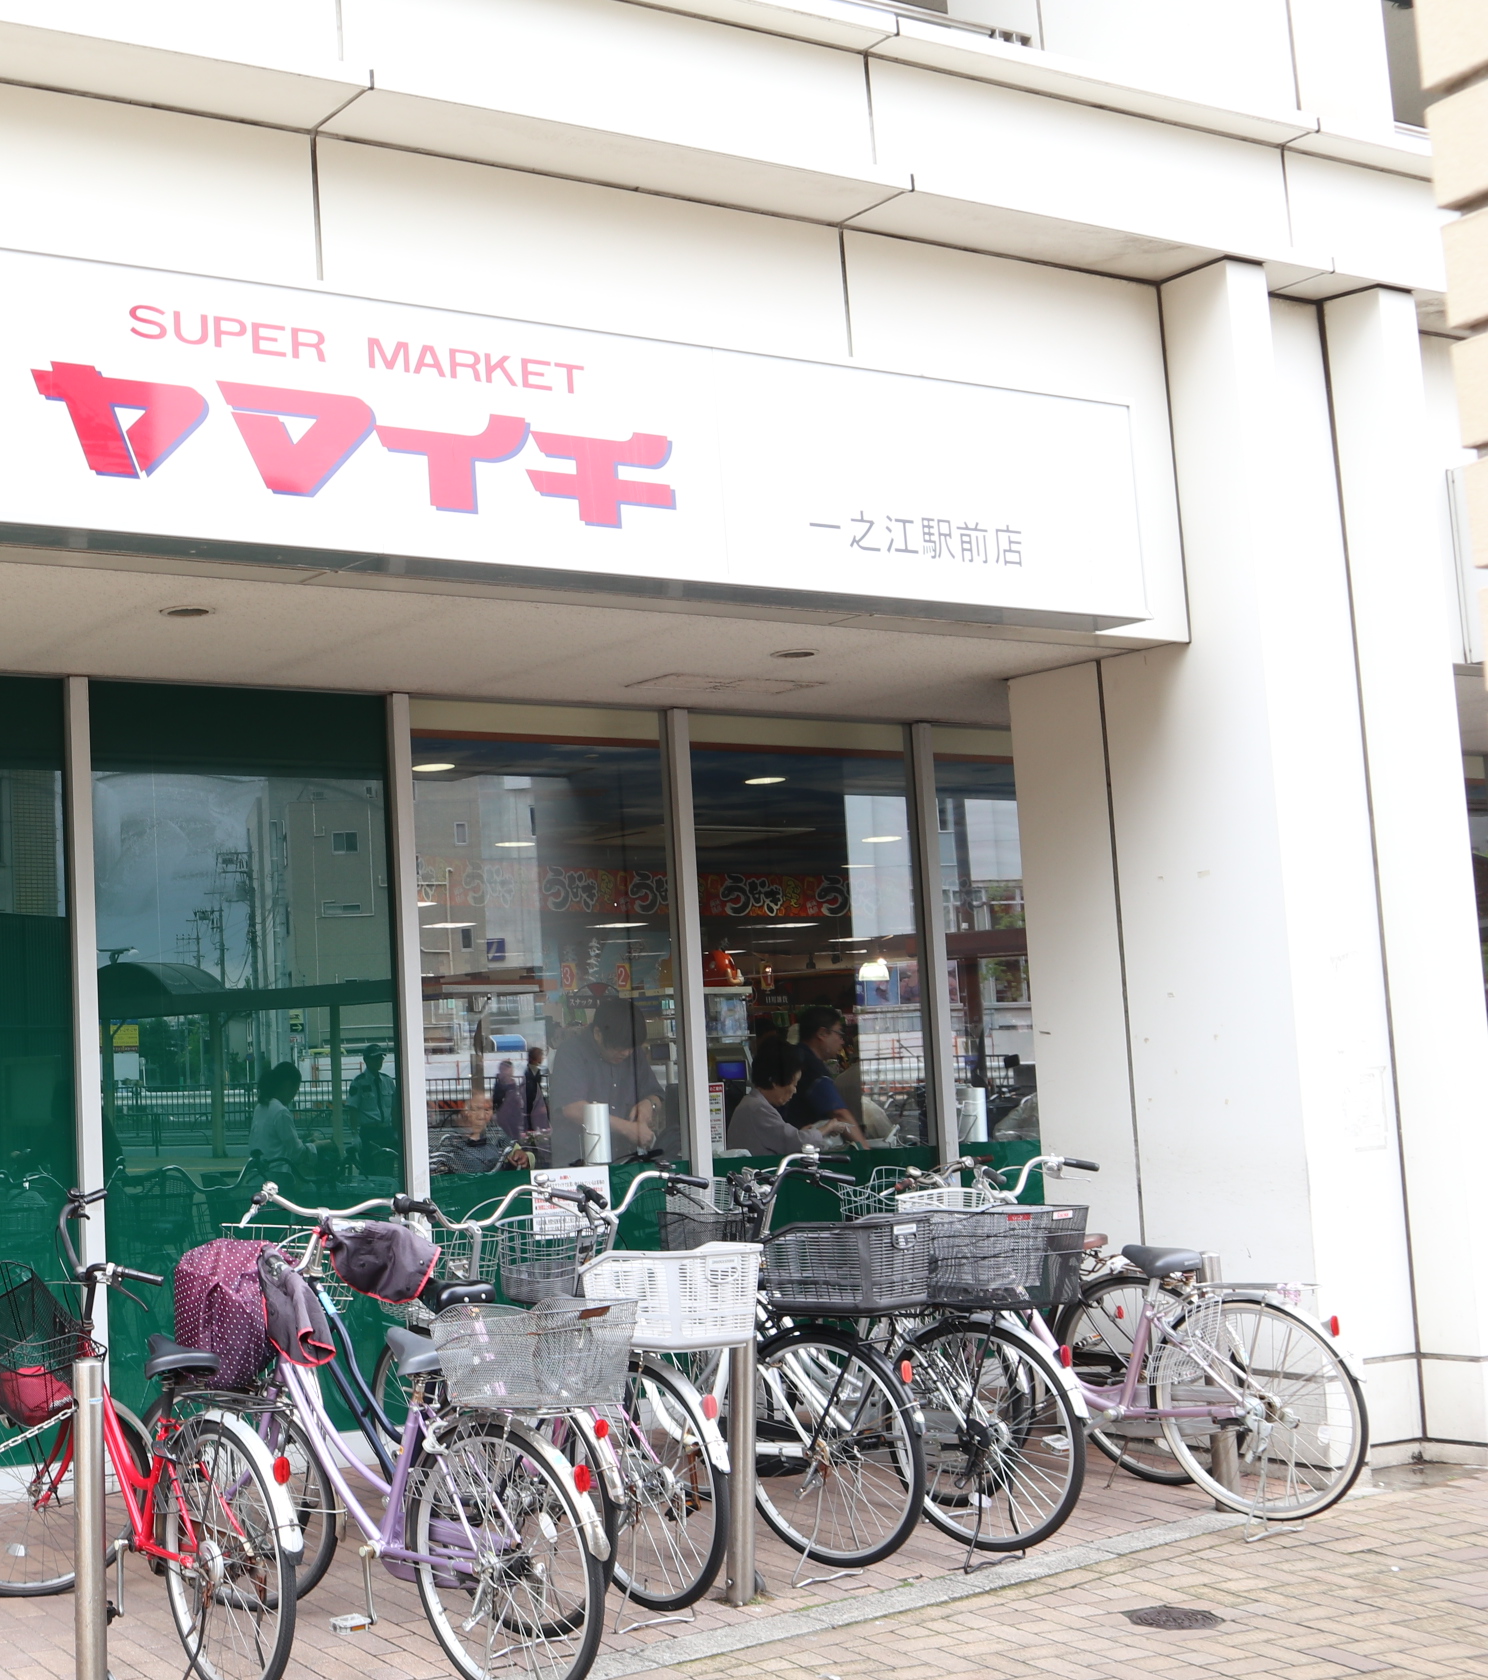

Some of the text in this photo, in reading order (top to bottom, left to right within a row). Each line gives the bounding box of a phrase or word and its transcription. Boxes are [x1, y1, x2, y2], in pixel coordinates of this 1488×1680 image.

[129, 304, 585, 394] SUPER MARKET
[30, 361, 677, 529] ヤマイチ
[809, 510, 1022, 567] 一之江駅前店
[542, 866, 598, 913] うなぎ
[720, 873, 783, 917] うなぎ
[563, 967, 571, 985] 3
[617, 967, 626, 985] 2
